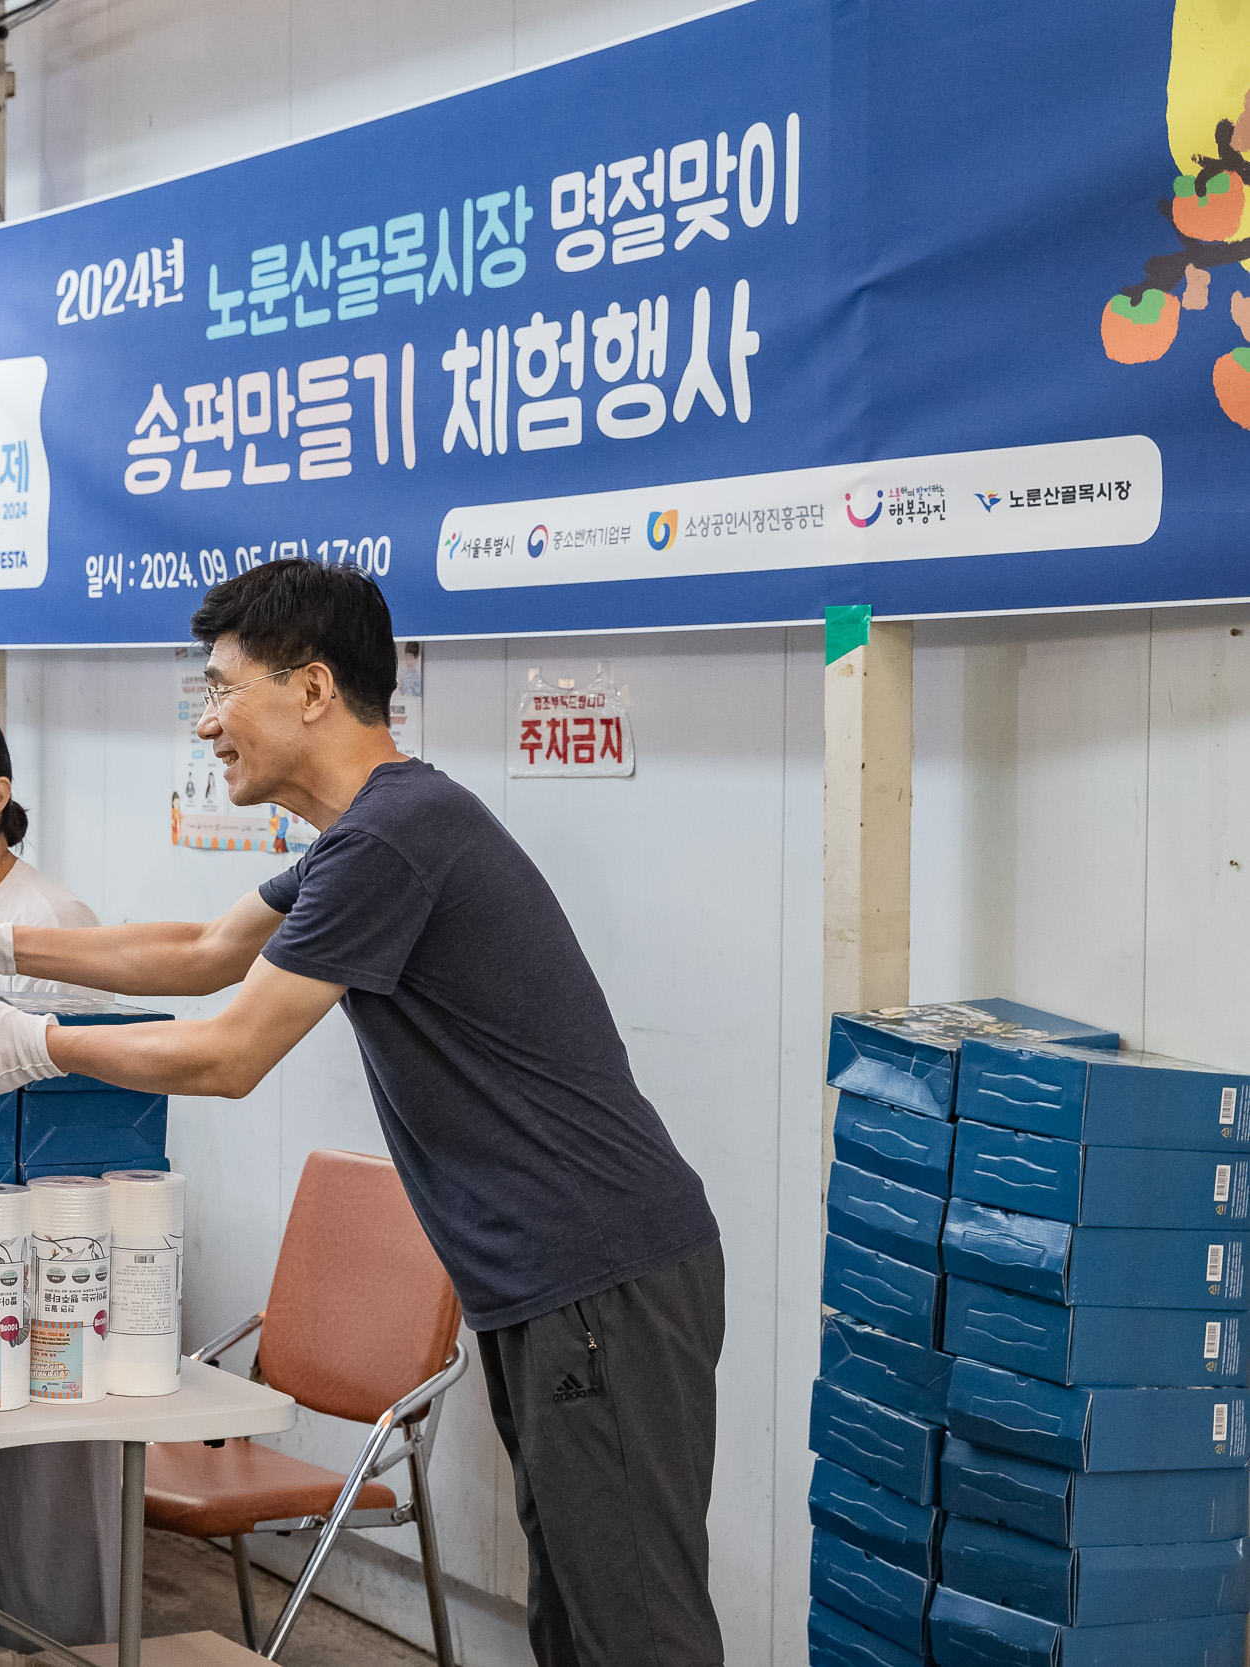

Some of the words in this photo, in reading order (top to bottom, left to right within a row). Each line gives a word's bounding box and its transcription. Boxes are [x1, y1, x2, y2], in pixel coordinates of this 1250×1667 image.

[55, 237, 185, 326] 2024년
[206, 184, 535, 341] 노룬산골목시장
[550, 112, 800, 273] 명절맞이
[124, 342, 416, 496] 송편만들기
[442, 278, 760, 457] 체험행사
[3, 501, 27, 520] 2024
[461, 535, 516, 559] 서울특별시
[552, 525, 631, 551] 중소벤처기업부
[685, 504, 824, 537] 소상공인시장진흥공단
[888, 499, 946, 525] 행복광진
[1009, 480, 1132, 509] 노룬산골목시장
[85, 552, 122, 599] 일시
[520, 716, 623, 765] 주차금지
